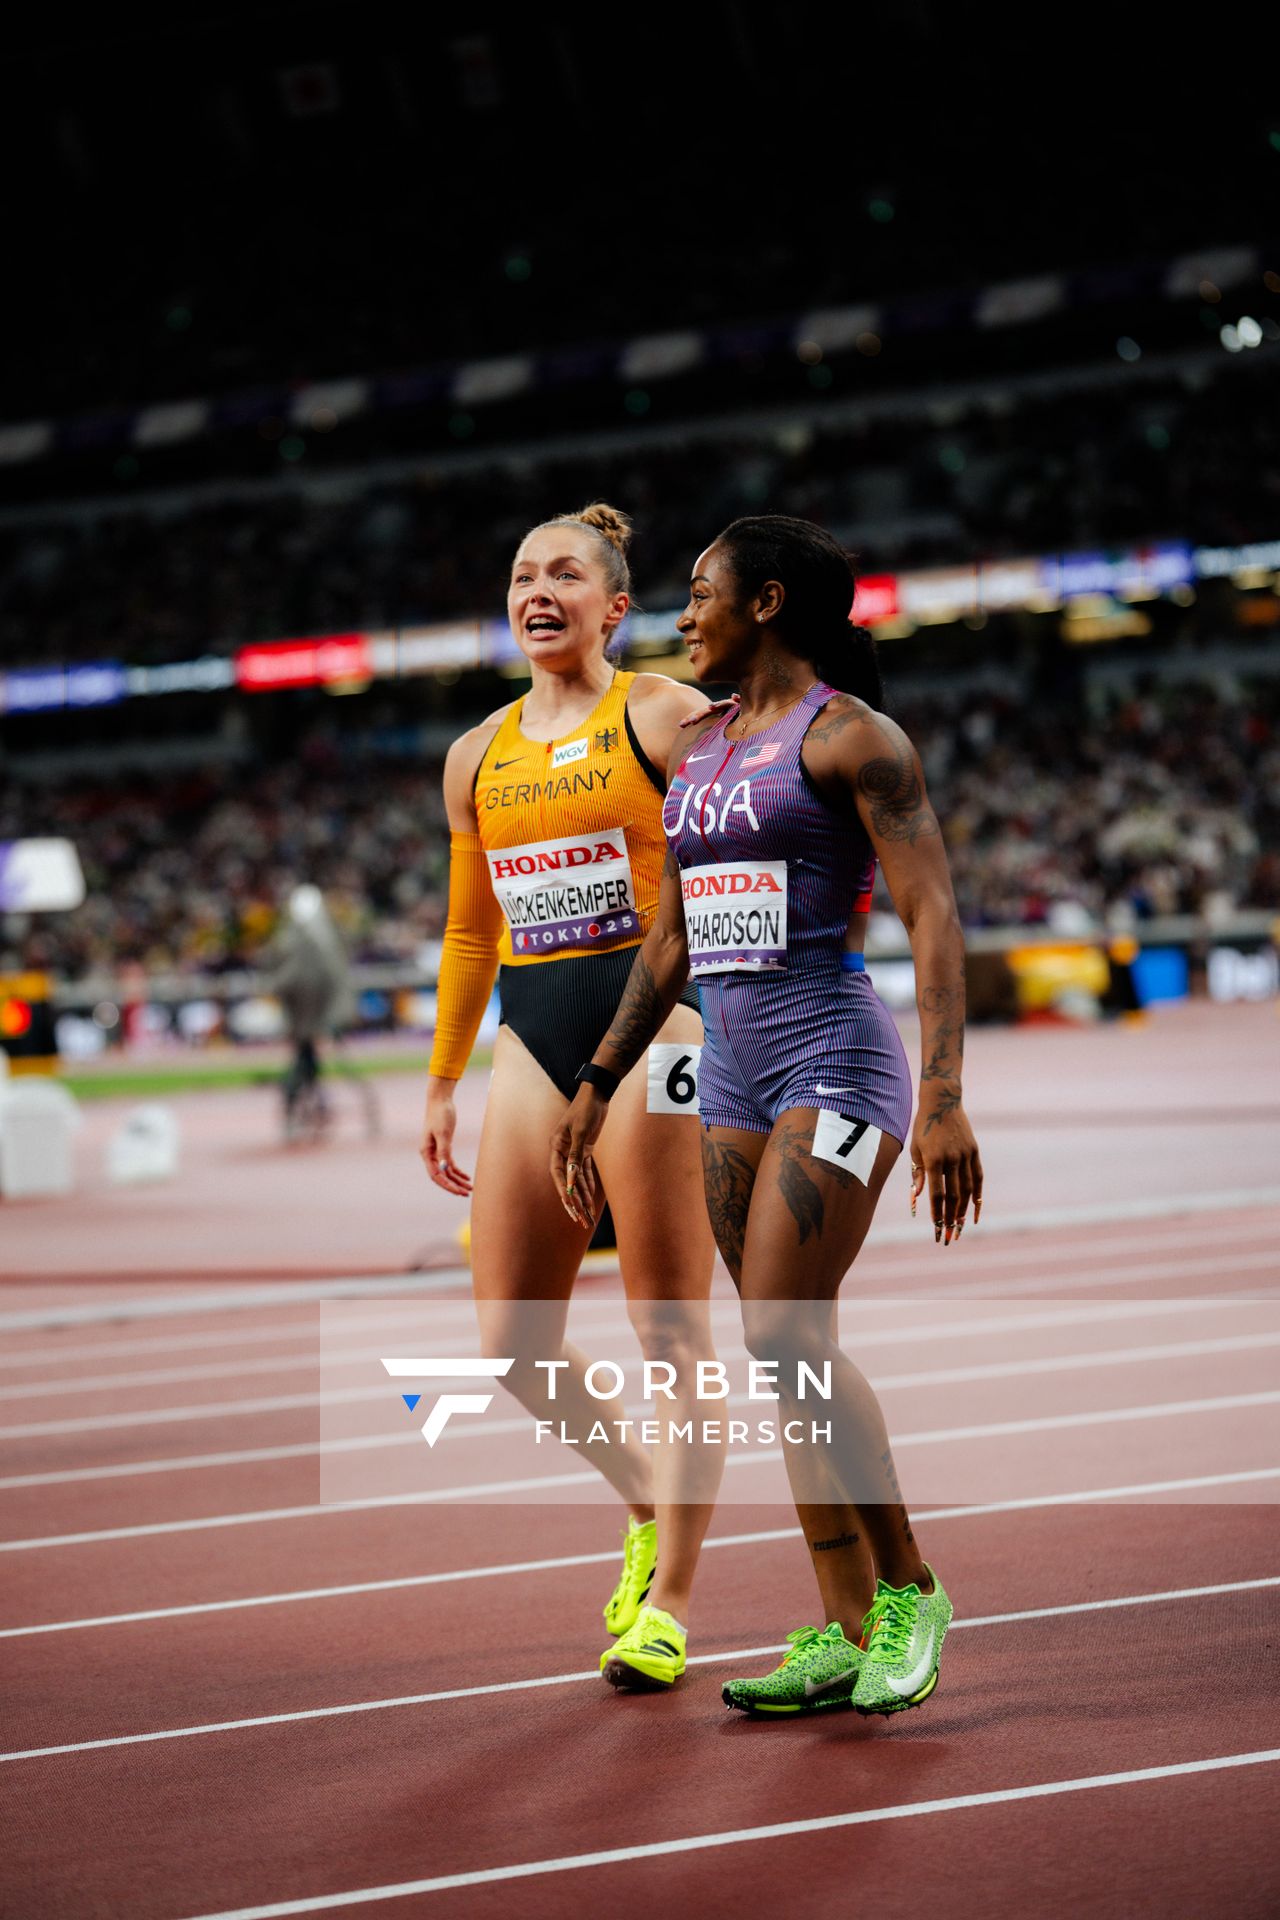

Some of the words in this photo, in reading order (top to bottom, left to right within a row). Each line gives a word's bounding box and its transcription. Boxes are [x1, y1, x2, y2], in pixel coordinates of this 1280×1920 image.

[554, 743, 587, 762] WGV
[485, 768, 612, 809] GERMANY
[662, 780, 760, 837] USA
[492, 841, 624, 879] HONDA
[501, 879, 630, 925] LÜCKENKEMPER
[682, 872, 783, 901] HONDA
[606, 916, 633, 933] 25
[687, 910, 780, 950] CHARDSON
[666, 1054, 696, 1105] 6
[835, 1112, 871, 1158] 7
